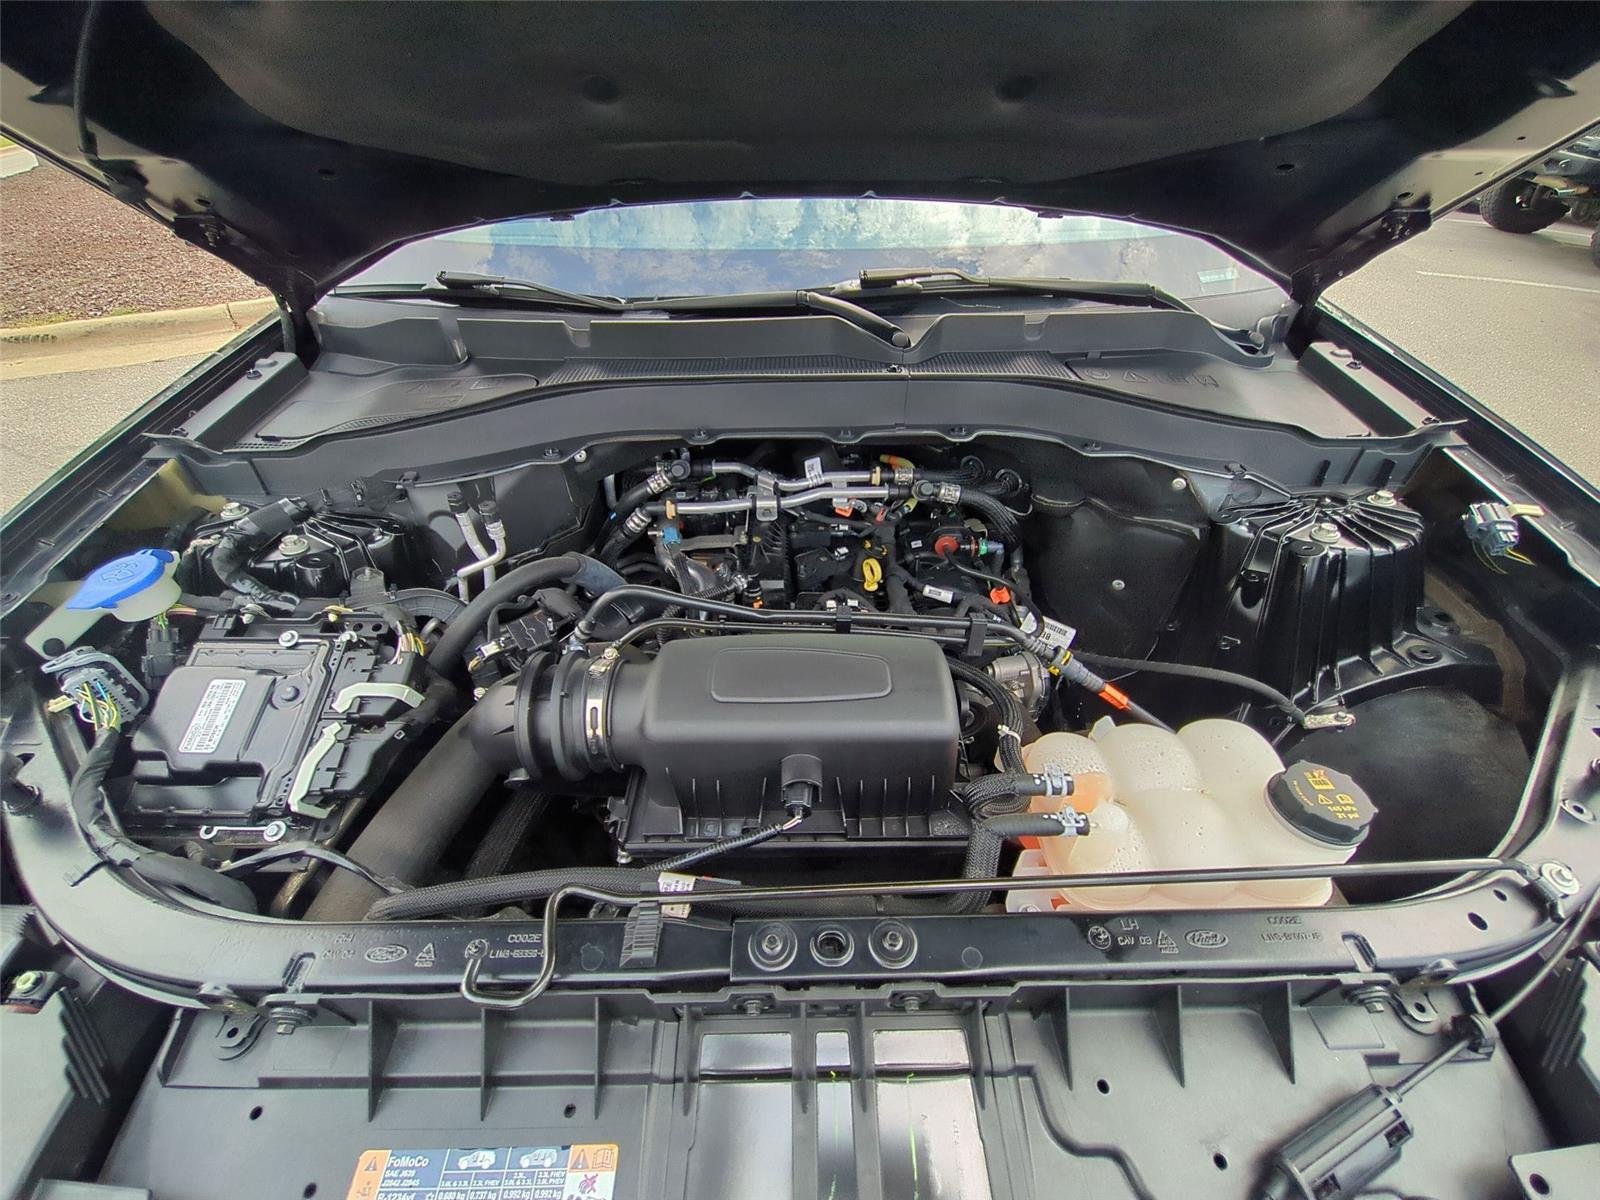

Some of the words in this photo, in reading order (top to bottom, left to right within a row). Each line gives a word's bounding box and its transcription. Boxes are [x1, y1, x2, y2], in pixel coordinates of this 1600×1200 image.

[387, 1155, 430, 1168] FoMoCo
[385, 1169, 400, 1178] SAE
[521, 1189, 531, 1200] kg
[552, 1189, 562, 1200] kg
